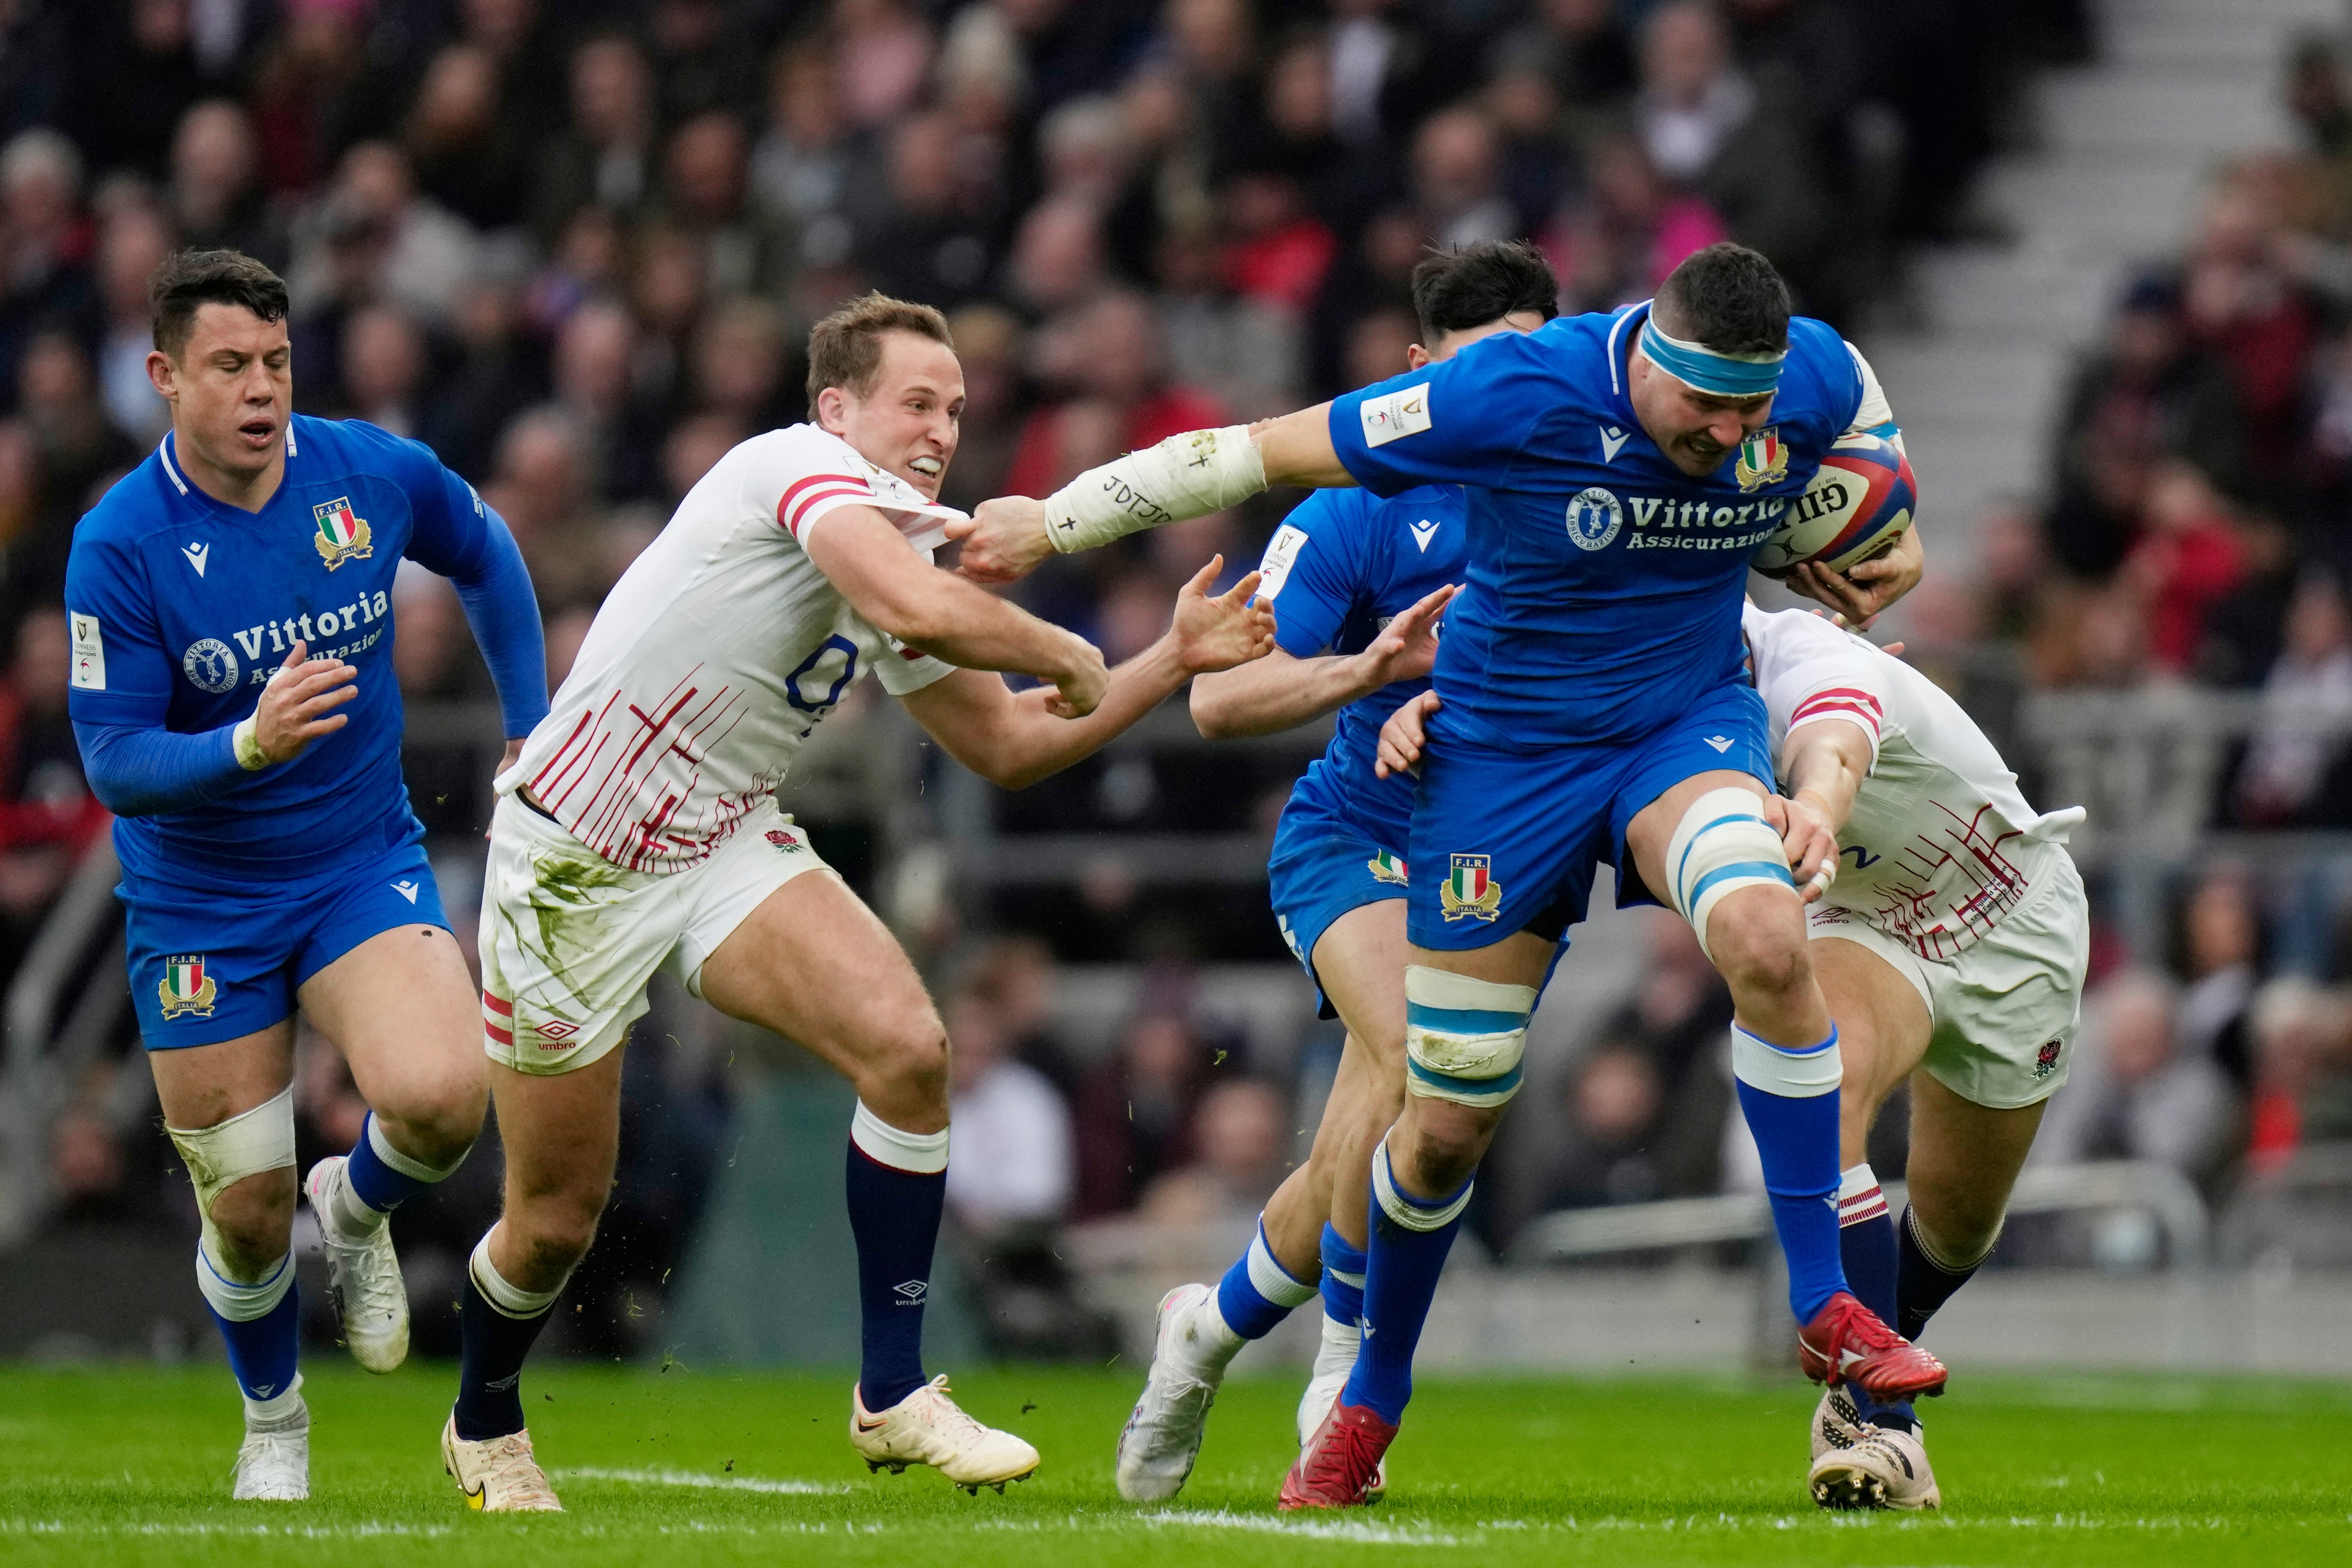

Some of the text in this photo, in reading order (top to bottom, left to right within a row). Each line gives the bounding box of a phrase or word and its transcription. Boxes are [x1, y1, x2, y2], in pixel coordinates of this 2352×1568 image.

[318, 502, 346, 516] F.I.R.
[1629, 497, 1785, 528] Vittoria
[1569, 514, 1618, 547] ASSICURAZIONI
[1626, 525, 1777, 550] Assicurazion
[337, 546, 358, 557] ITALIA
[1267, 559, 1284, 569] NATIONS
[233, 590, 388, 661] Vittoria
[187, 641, 229, 659] VITTORIA
[1455, 858, 1486, 867] F.I.R.
[1389, 874, 1408, 884] ITALI
[1813, 918, 1849, 927] umbro
[171, 955, 200, 964] F.I.R.
[539, 1042, 576, 1051] umbro
